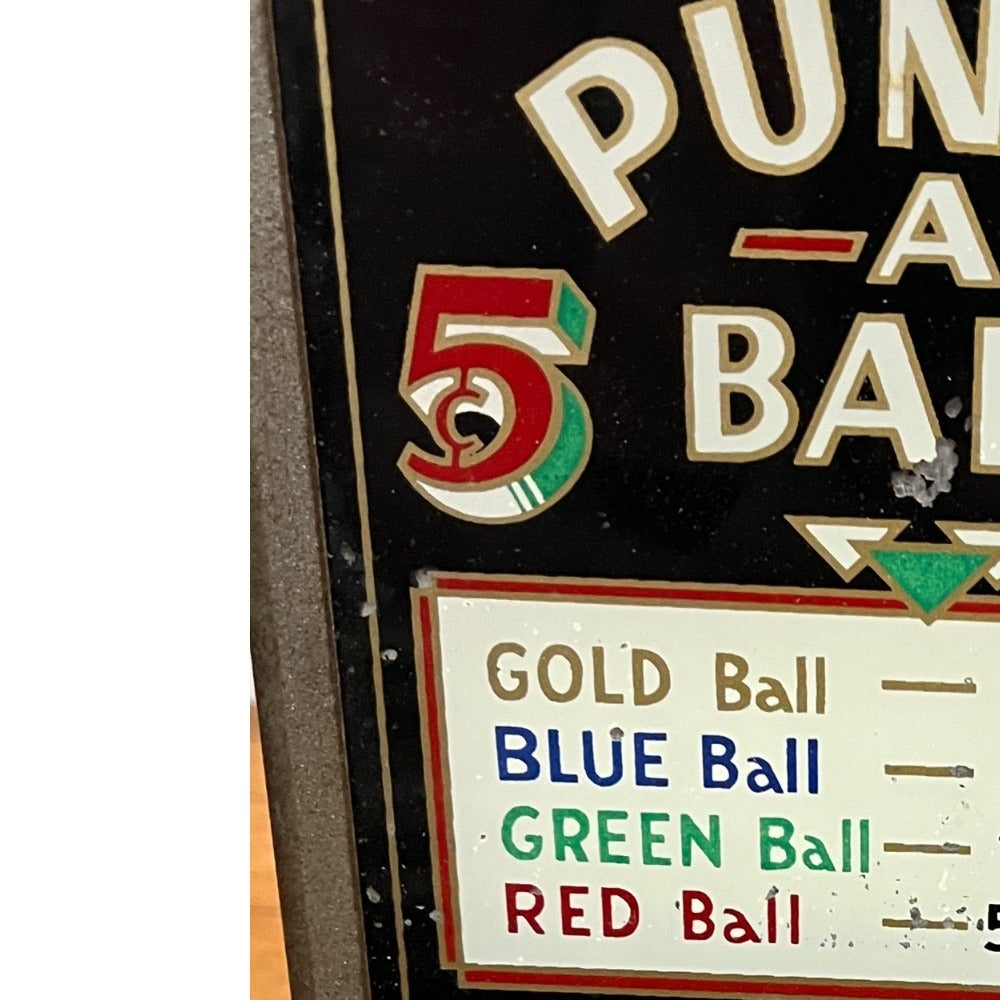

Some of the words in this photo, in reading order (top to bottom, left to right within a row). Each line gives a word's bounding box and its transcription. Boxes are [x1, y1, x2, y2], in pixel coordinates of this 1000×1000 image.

[486, 641, 671, 706] GOLD
[715, 651, 826, 714] Ball
[494, 725, 669, 788] BLUE
[701, 734, 819, 795] Ball
[500, 805, 722, 869] GREEN
[759, 817, 870, 874] Ball
[504, 882, 640, 939] RED
[681, 890, 800, 945] Ball
